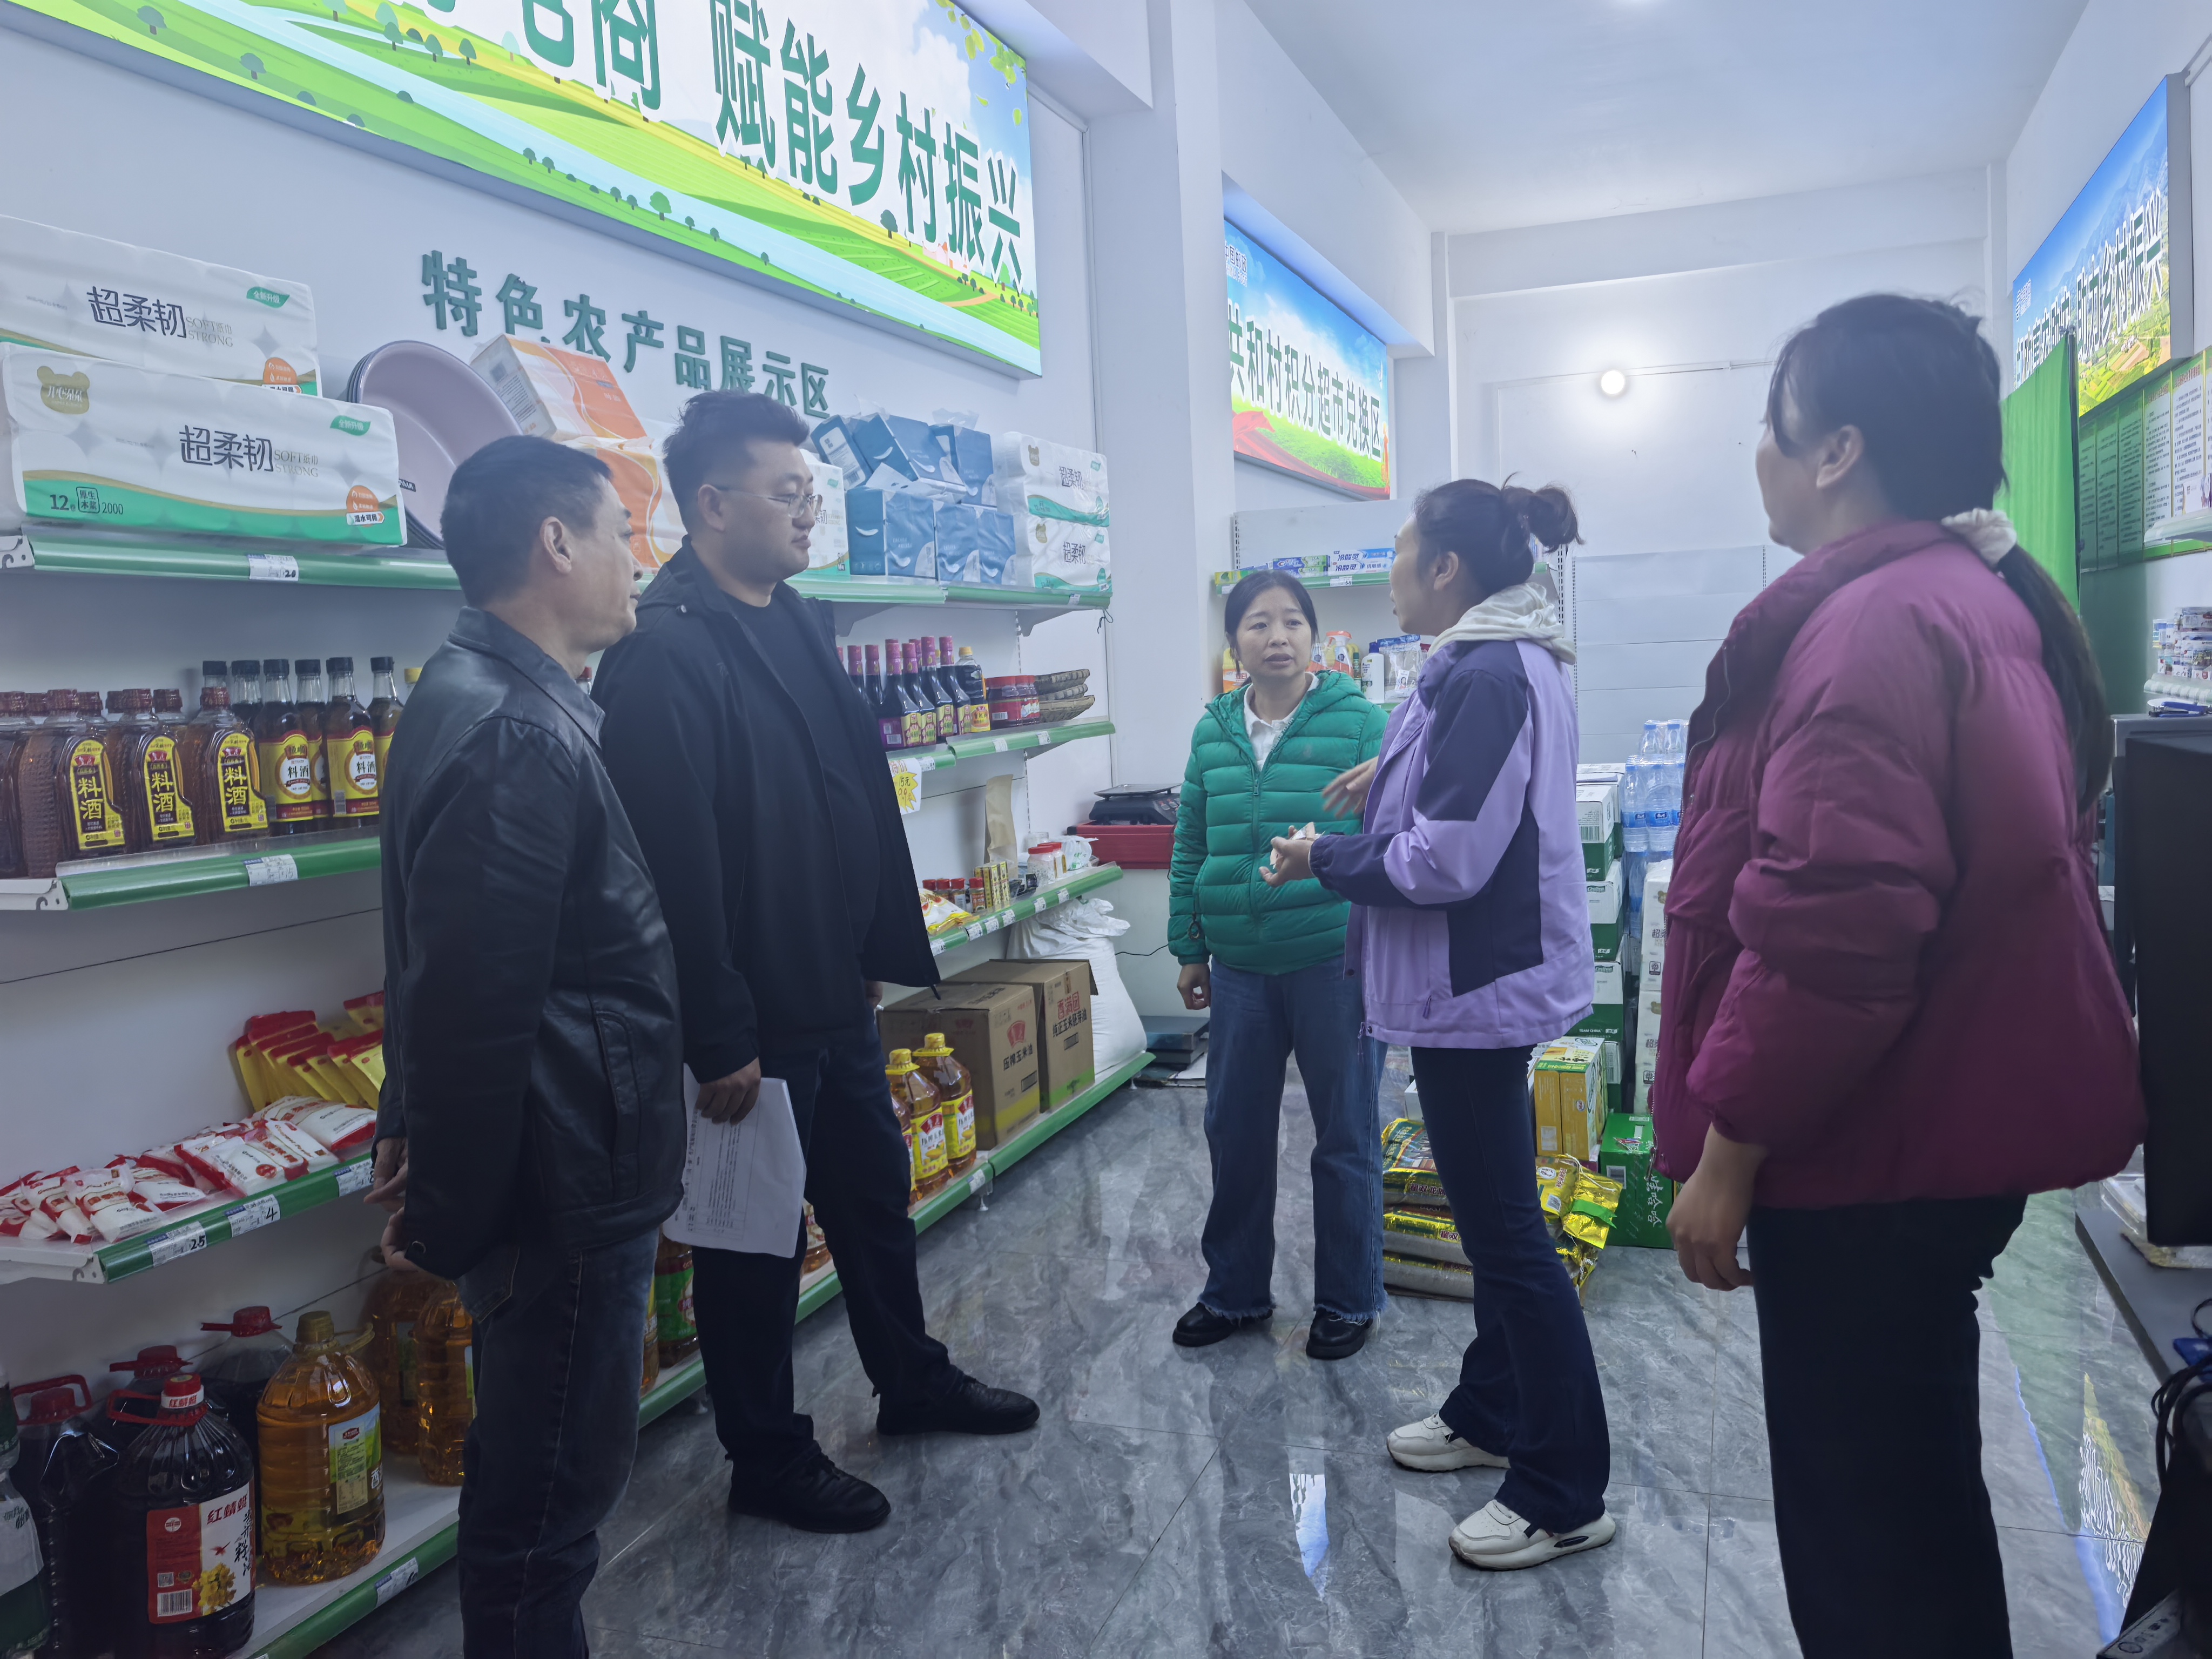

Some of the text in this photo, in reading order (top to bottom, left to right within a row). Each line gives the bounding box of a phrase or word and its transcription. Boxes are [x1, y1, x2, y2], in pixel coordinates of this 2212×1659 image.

[709, 0, 1024, 286] 赋能乡村振兴
[2078, 190, 2162, 358] 助力乡村振兴
[253, 290, 280, 304] 全新升级
[86, 286, 186, 338] 超柔韧
[188, 330, 233, 347] STRONG
[421, 250, 830, 419] 特色农产品展示区
[1228, 304, 1383, 458] 共和村积分超市兑换区
[179, 425, 274, 472] 超柔韧
[274, 463, 318, 477] STRONG
[1059, 466, 1084, 490] 超柔韧
[102, 502, 124, 515] 2000
[1063, 541, 1087, 564] 超柔韧
[1338, 553, 1359, 561] 冷酸灵
[284, 569, 296, 578] 20
[1336, 563, 1357, 572] 冷酸灵
[287, 764, 309, 779] 料酒
[356, 760, 376, 773] 料酒
[78, 776, 104, 819] 料酒
[151, 771, 176, 812] 料酒
[224, 766, 248, 805] 料酒
[1056, 991, 1080, 1020] 香满园
[1003, 1043, 1033, 1071] 压榨玉米油
[1646, 1174, 1663, 1227] 娃哈哈
[266, 1207, 278, 1221] 4
[191, 1235, 205, 1251] 25
[207, 1493, 247, 1525] 红蜻蜓
